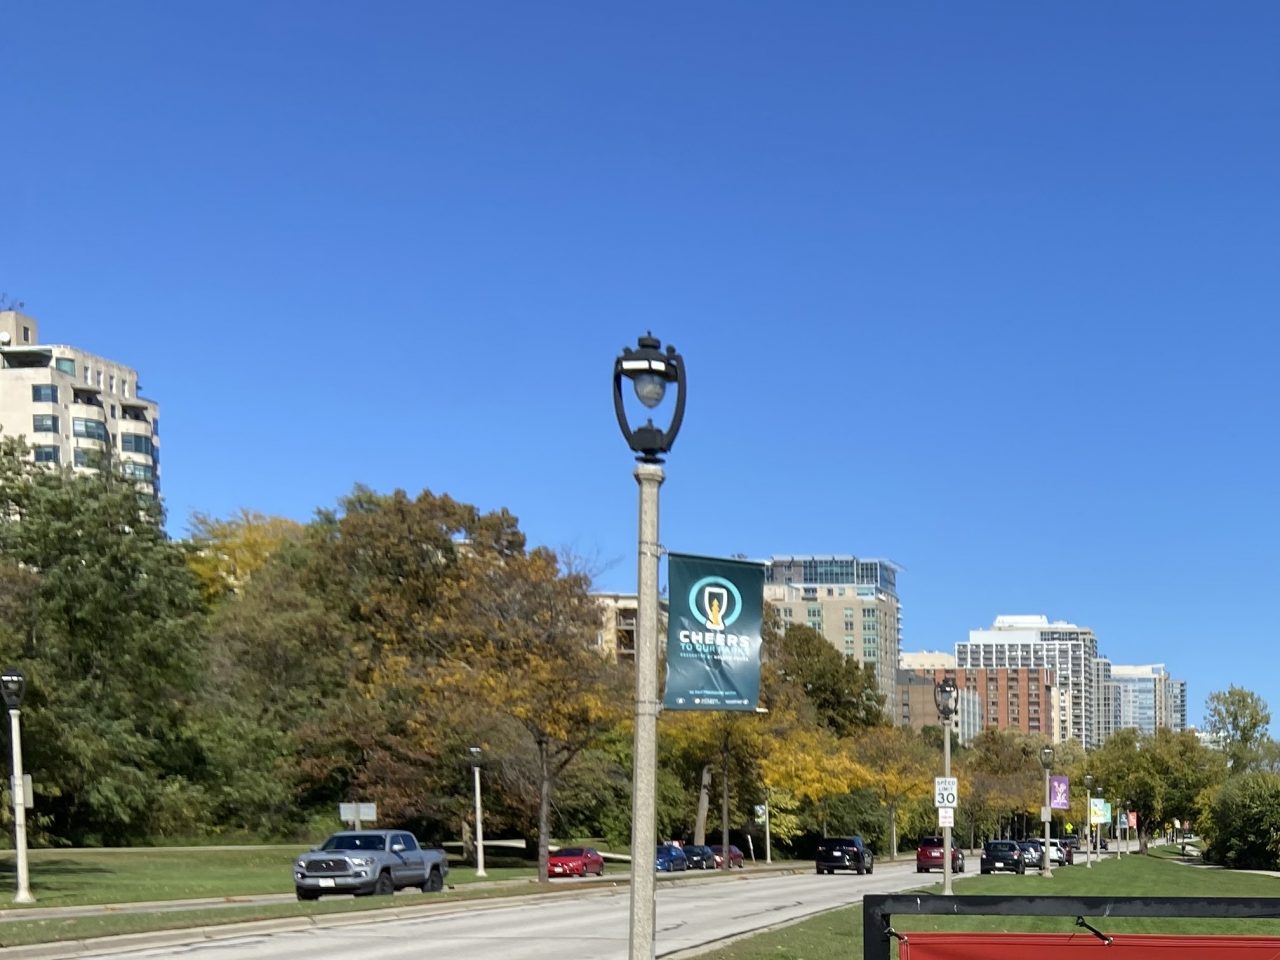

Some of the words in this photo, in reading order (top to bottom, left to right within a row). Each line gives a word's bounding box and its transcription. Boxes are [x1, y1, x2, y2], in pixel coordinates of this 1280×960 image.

[680, 630, 751, 650] CHEERS
[680, 643, 693, 651] TO
[695, 643, 716, 653] OUR
[937, 792, 956, 804] 30
